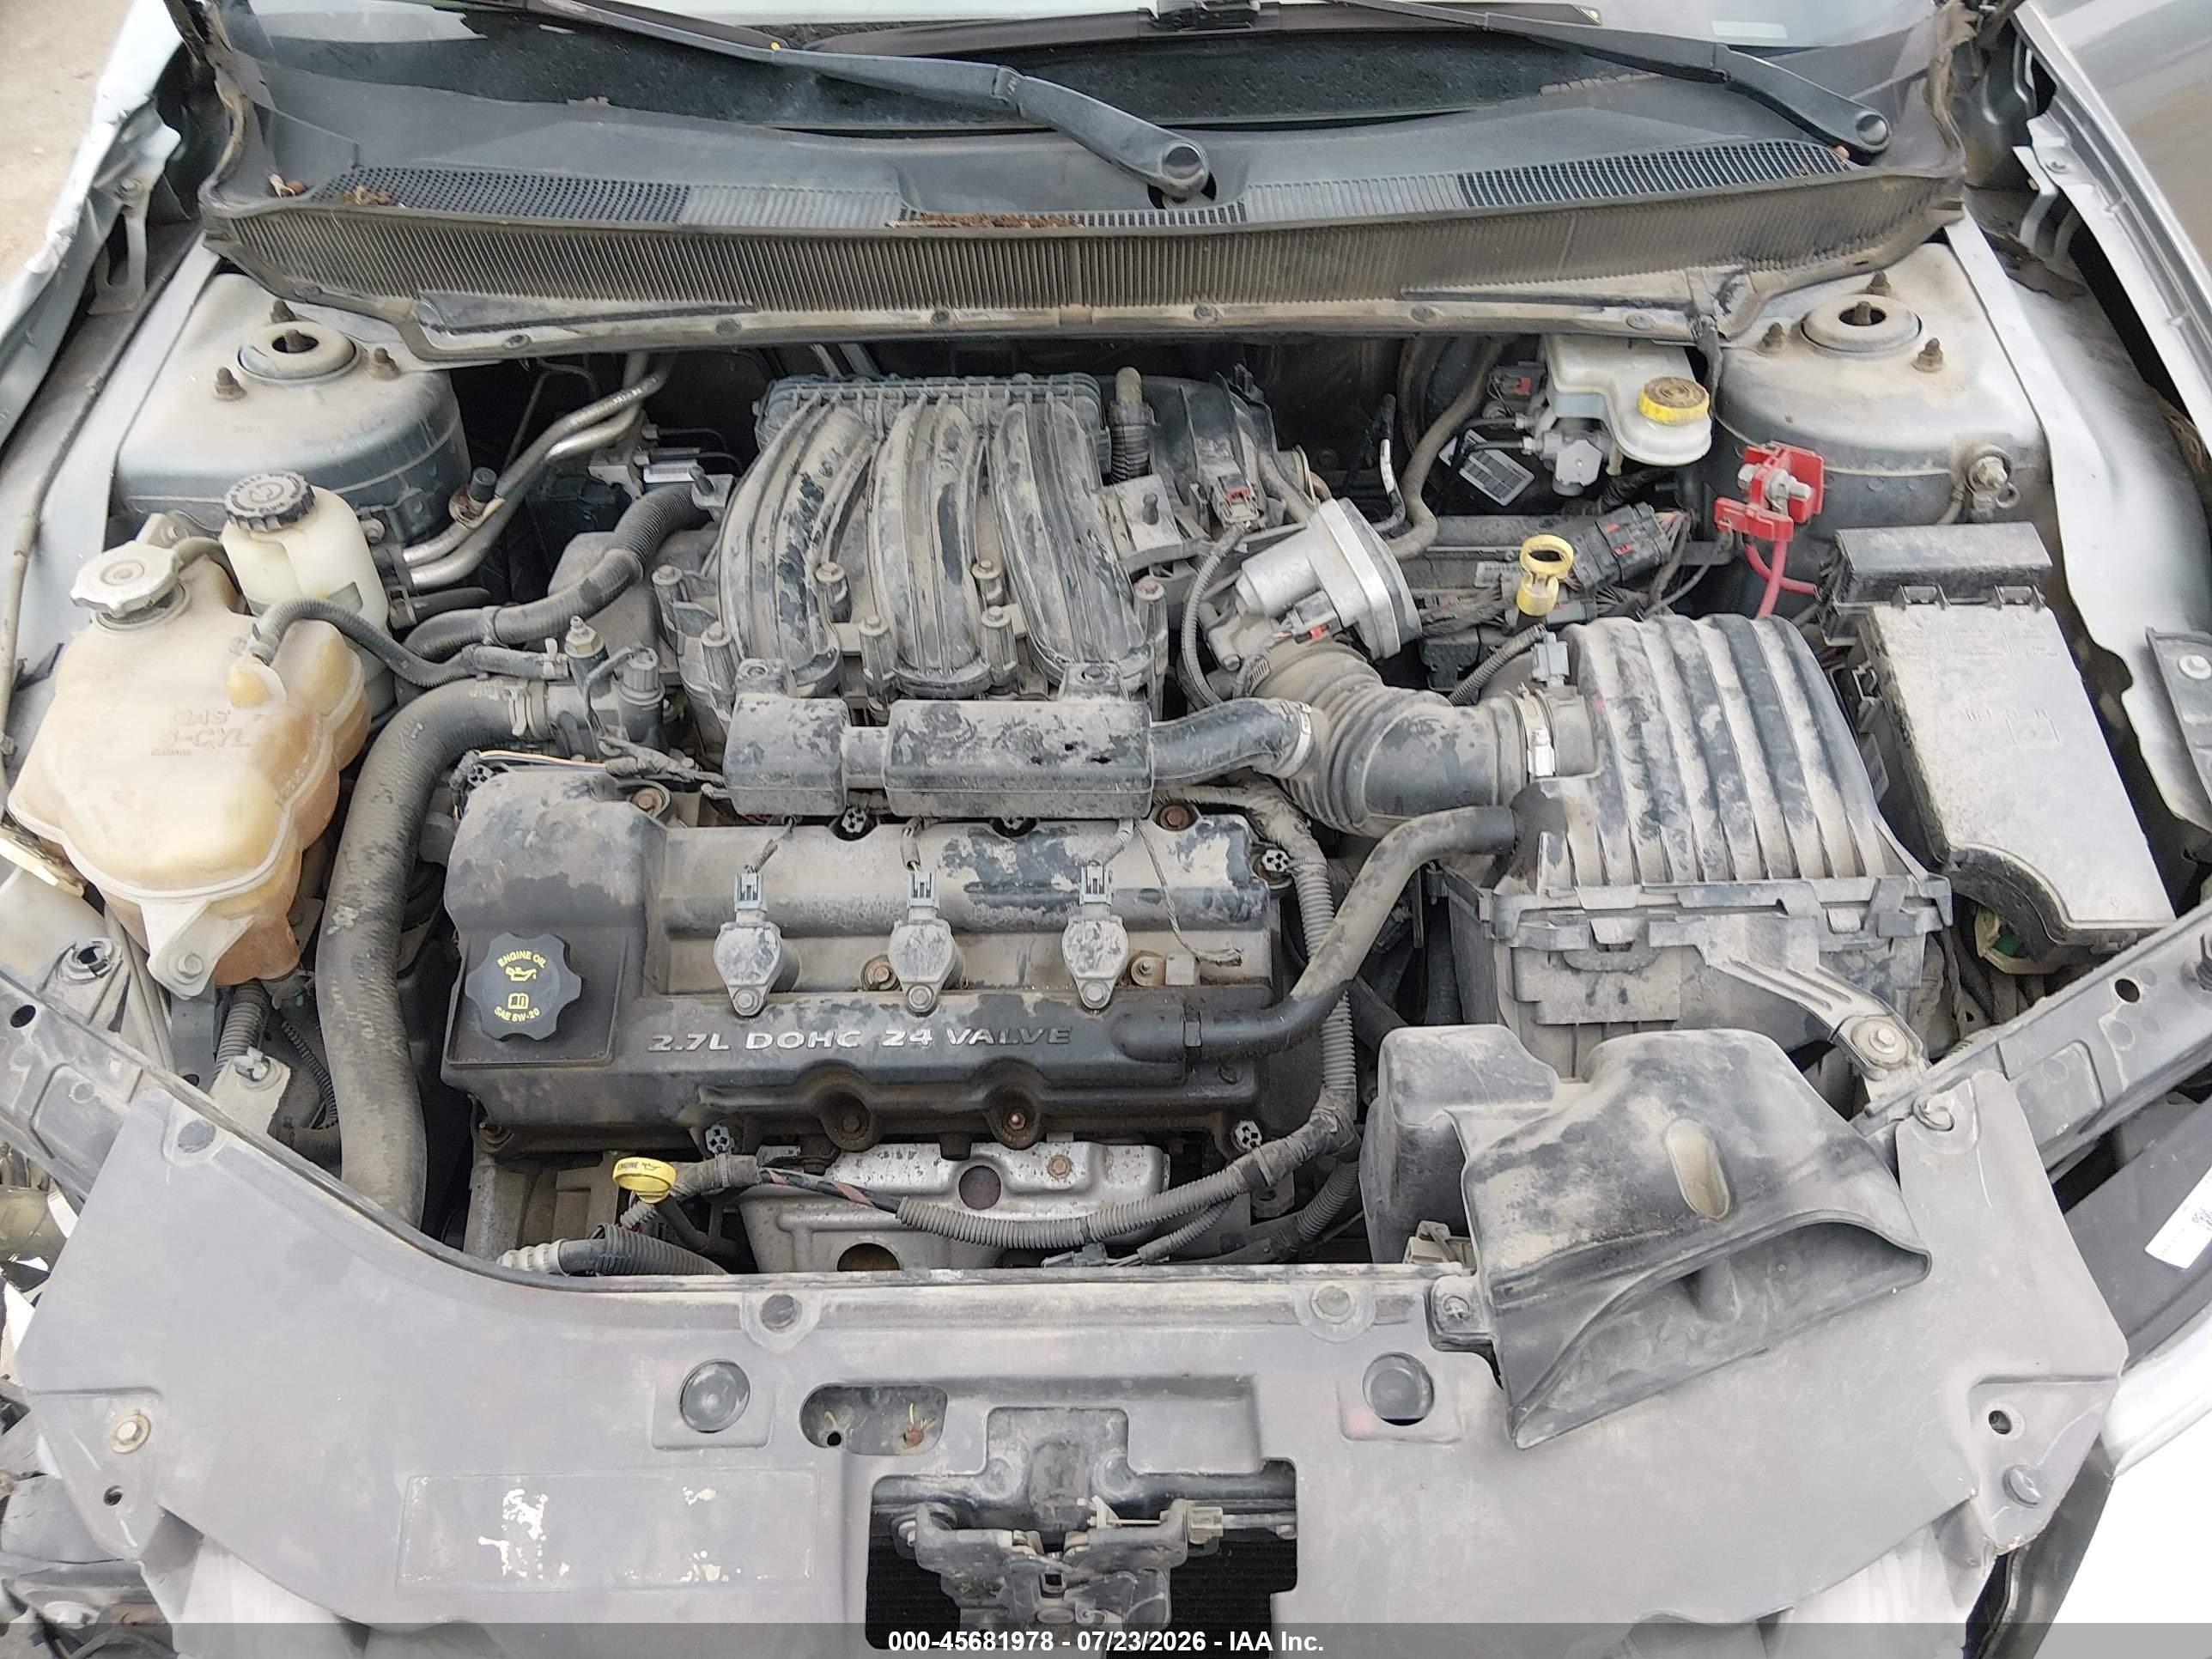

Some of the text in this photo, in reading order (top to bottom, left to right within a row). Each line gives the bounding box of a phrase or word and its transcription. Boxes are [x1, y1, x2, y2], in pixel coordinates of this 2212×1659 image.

[497, 951, 546, 969] ENGINE OIL
[495, 1006, 539, 1022] SAE 5W-20
[647, 1027, 1072, 1052] 2.7L DOHC 24 VALVE
